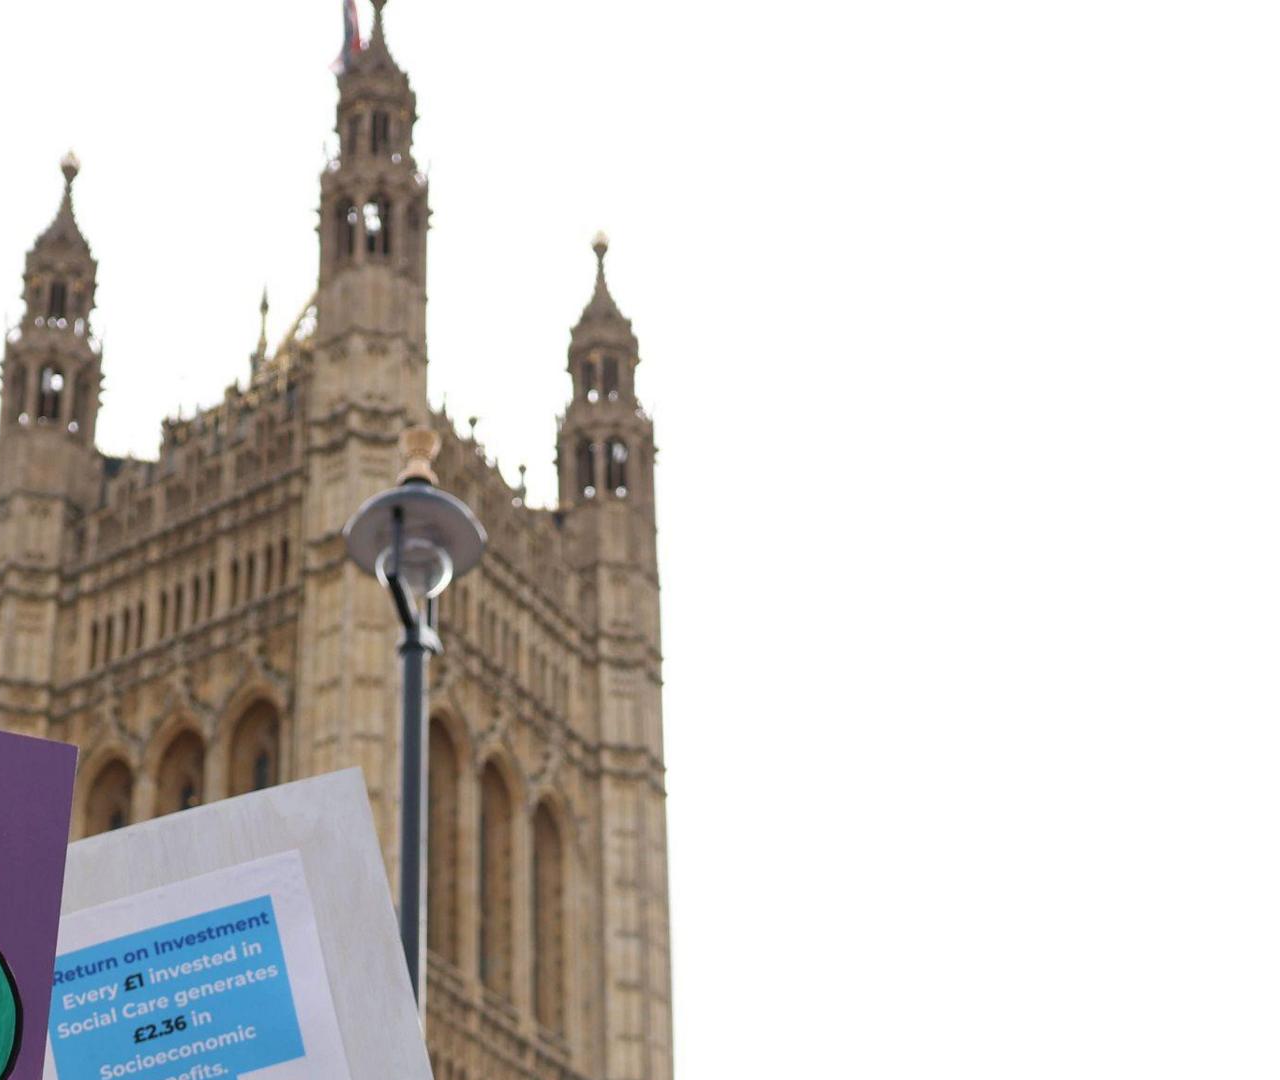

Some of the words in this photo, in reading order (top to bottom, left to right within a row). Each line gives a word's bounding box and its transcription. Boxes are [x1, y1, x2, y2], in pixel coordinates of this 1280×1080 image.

[53, 956, 118, 986] Return
[124, 947, 148, 964] on
[154, 911, 269, 956] Investment
[62, 983, 118, 1010] Every
[124, 973, 144, 992] £1
[149, 946, 236, 984] invested
[242, 941, 262, 957] in
[57, 1008, 117, 1040] Social
[122, 995, 168, 1019] Care
[174, 964, 278, 1007] generates
[134, 1015, 187, 1044] £2.36
[191, 1010, 212, 1026] in
[100, 1024, 256, 1080] Socioeconomic
